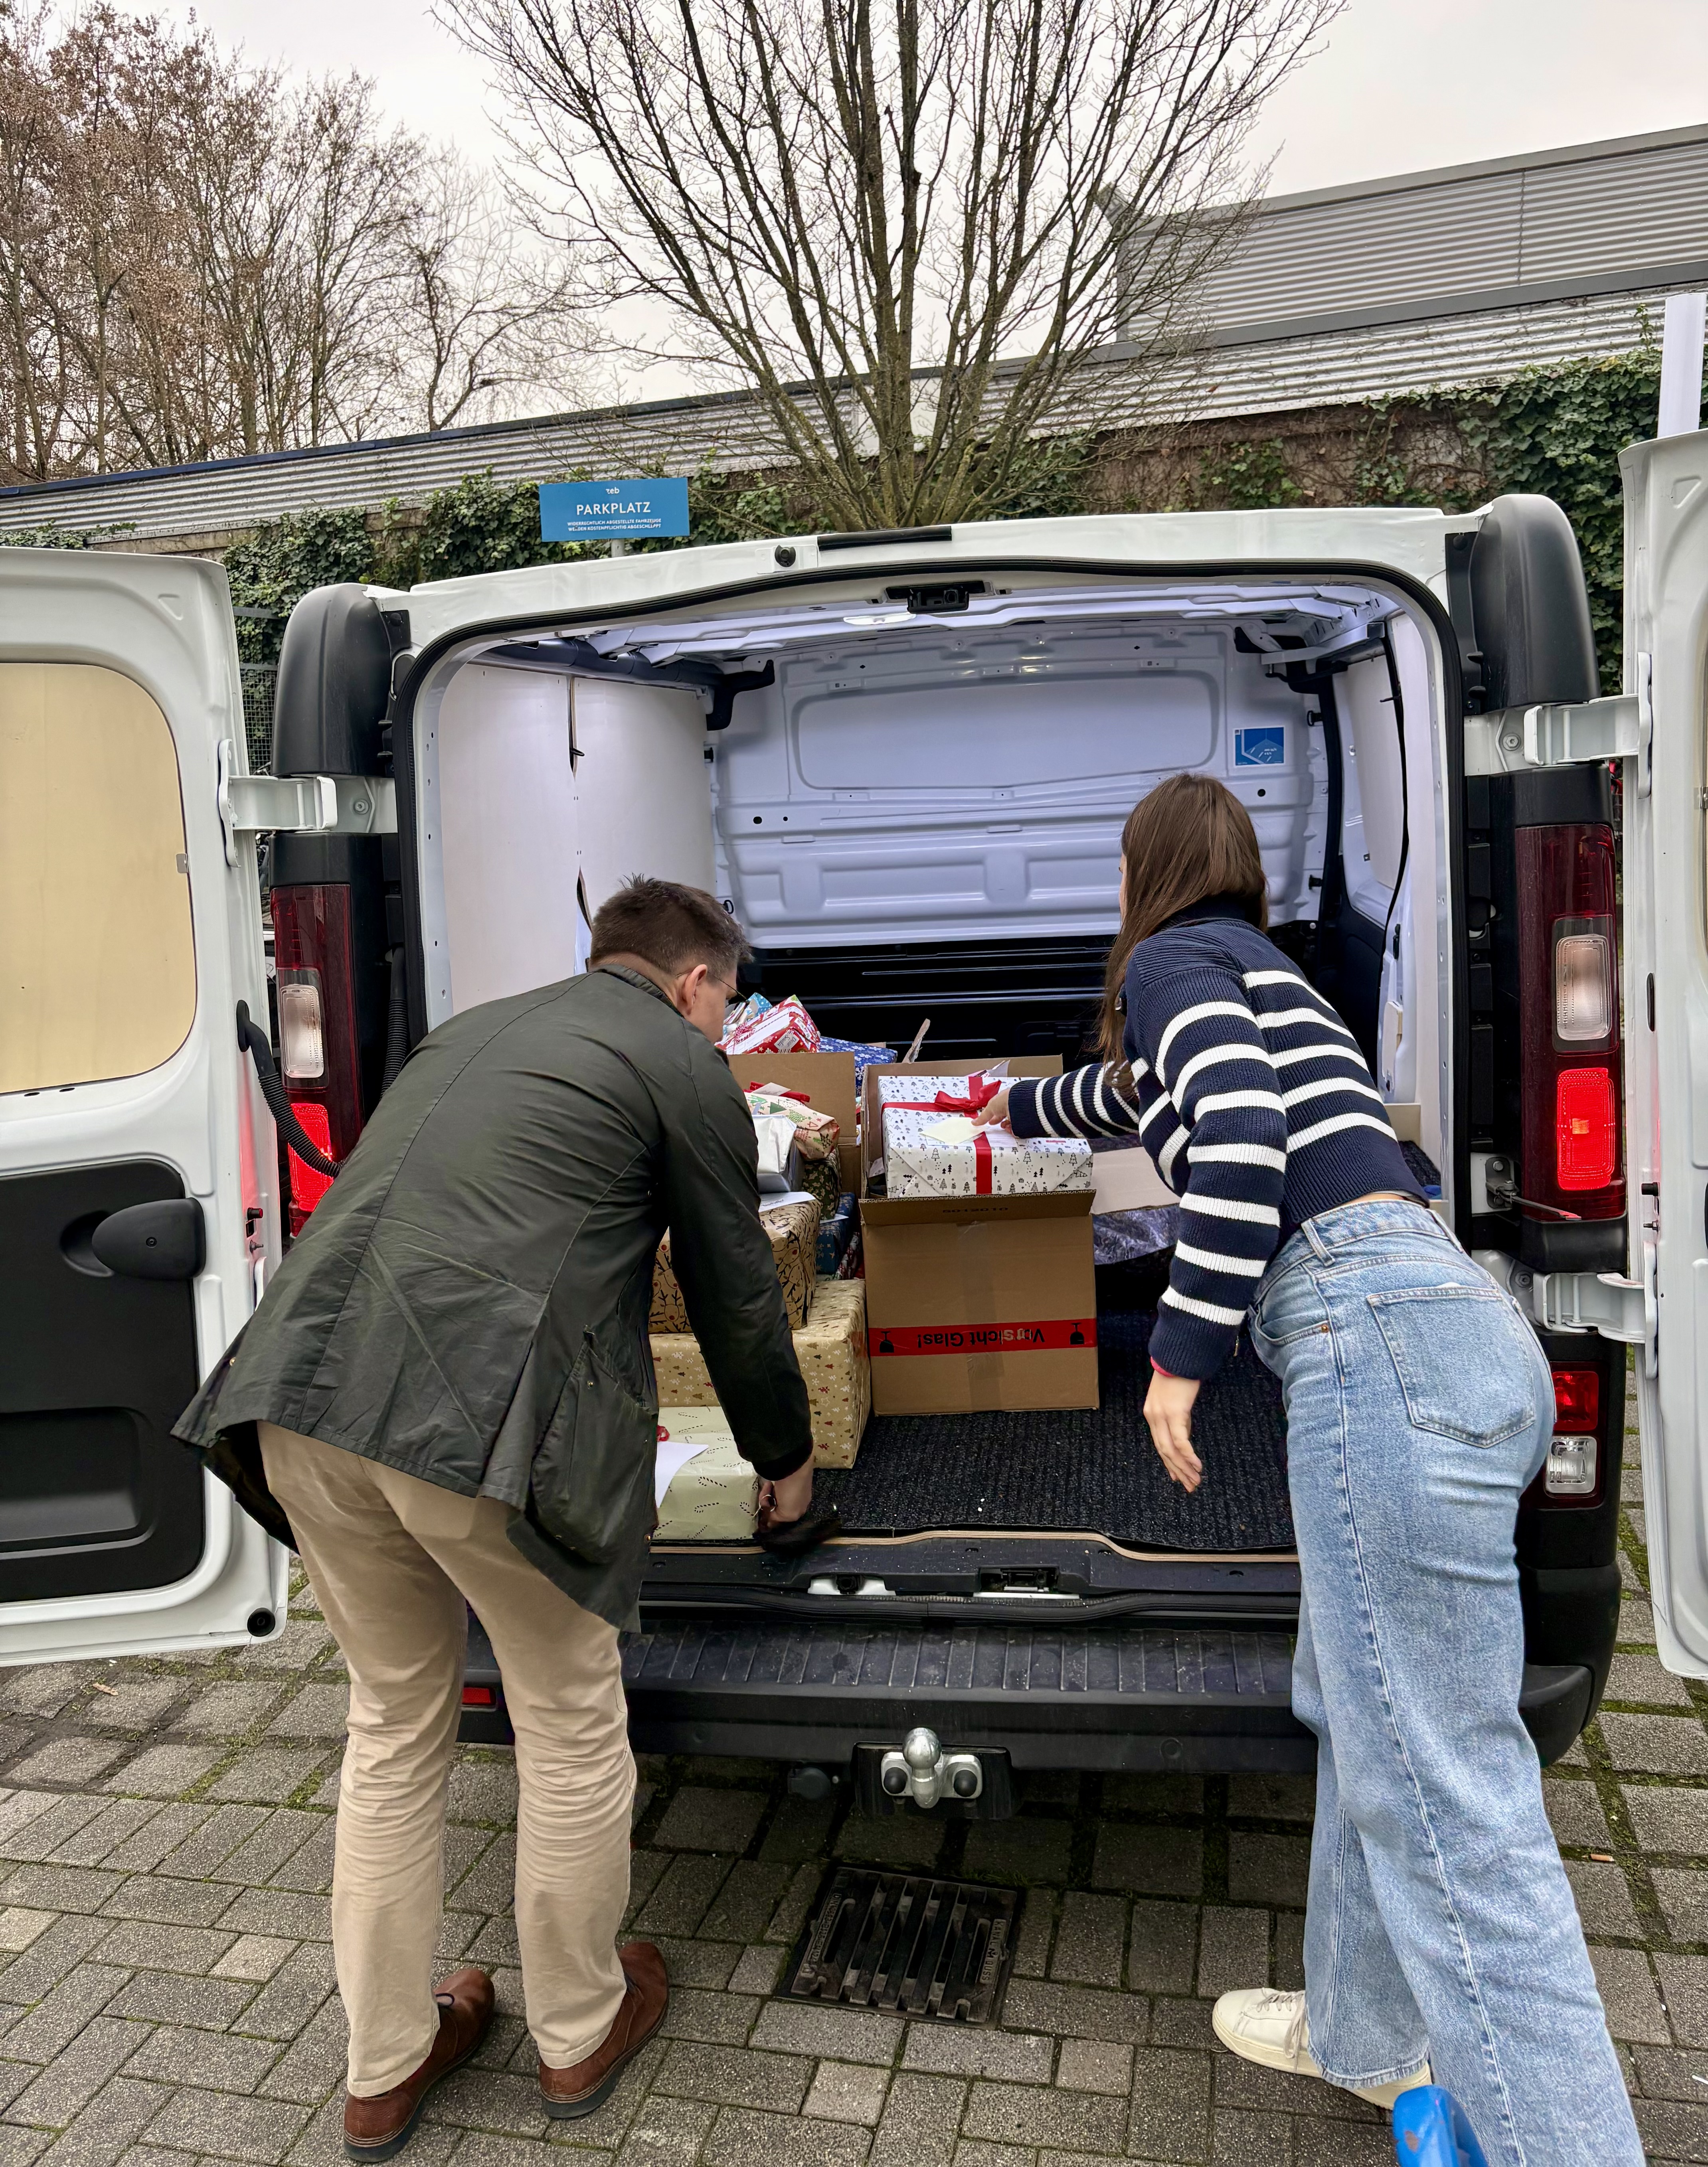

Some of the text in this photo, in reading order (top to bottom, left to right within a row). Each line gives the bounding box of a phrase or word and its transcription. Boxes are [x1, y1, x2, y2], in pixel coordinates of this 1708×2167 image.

[577, 502, 651, 516] PARKPLATZ
[777, 1034, 790, 1047] Santa
[917, 1328, 1045, 1348] Vorsicht Glas!
[990, 1922, 1004, 1945] KANAL
